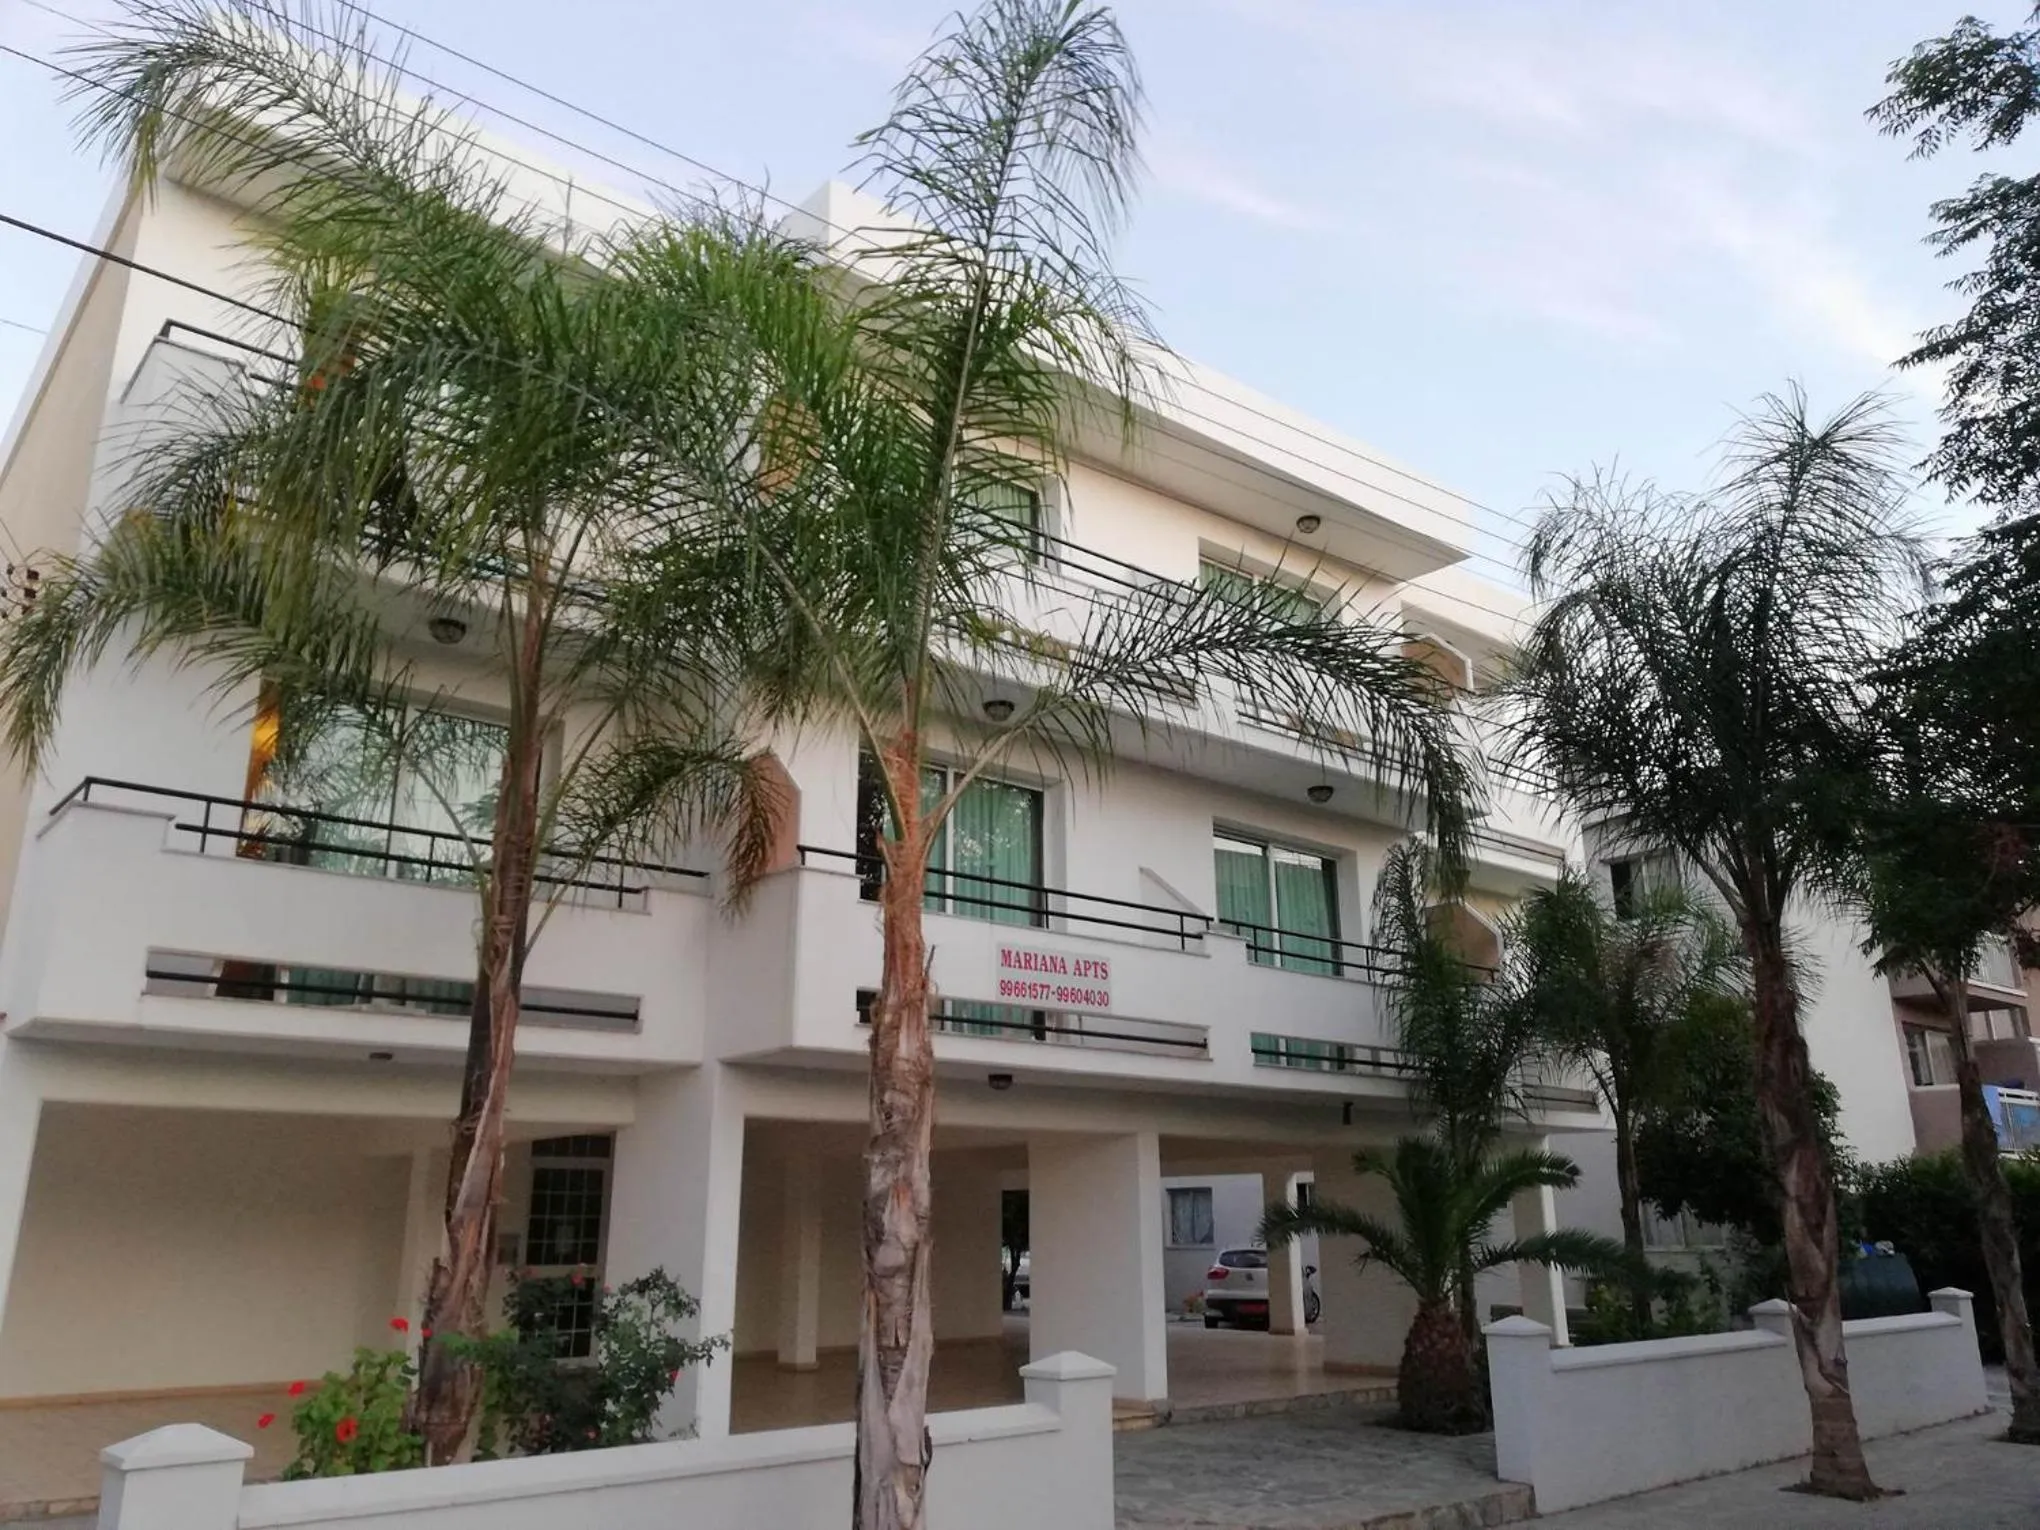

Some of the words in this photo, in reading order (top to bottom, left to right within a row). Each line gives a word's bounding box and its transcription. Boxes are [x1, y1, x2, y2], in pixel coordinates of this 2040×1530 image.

[1000, 949, 1068, 975] MARIANA
[1073, 958, 1109, 980] APTS
[999, 979, 1110, 1007] 99661577-99604030
